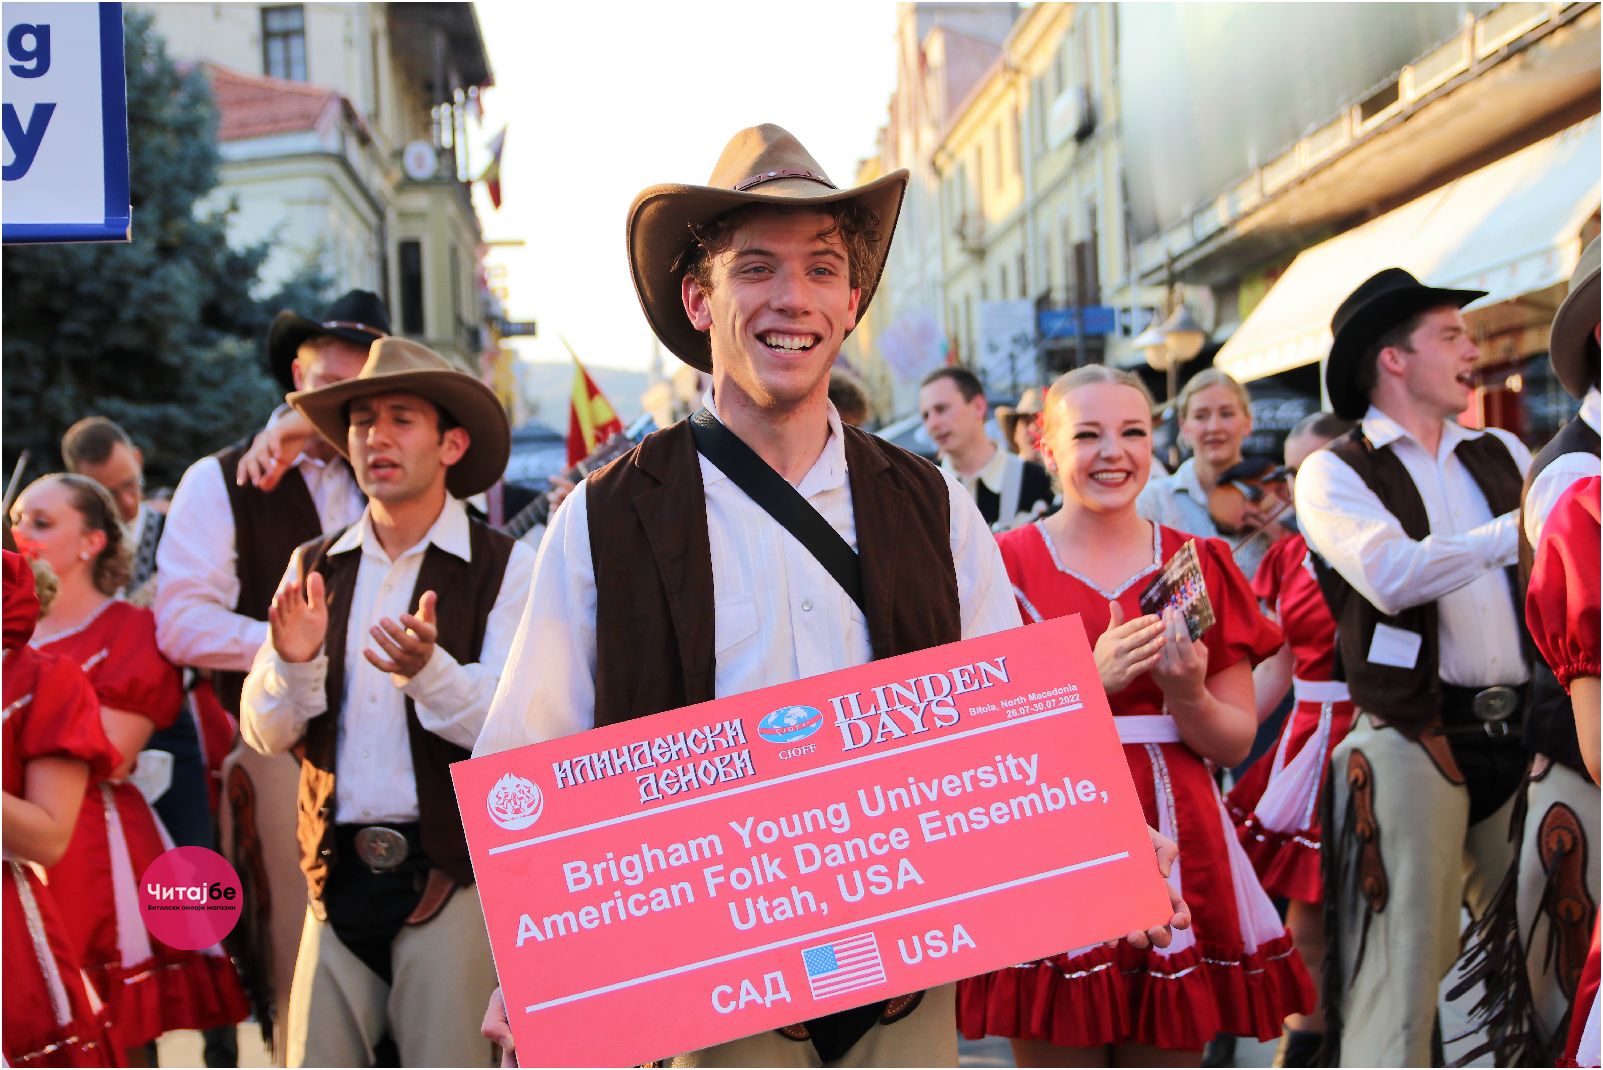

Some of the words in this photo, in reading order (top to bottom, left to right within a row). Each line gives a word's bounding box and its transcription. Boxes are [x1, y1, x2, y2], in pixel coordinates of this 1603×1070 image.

[828, 656, 1010, 726] ILINDEN
[968, 703, 999, 717] Bitola,
[1000, 696, 1026, 709] North
[1028, 683, 1078, 701] Macedonia
[1005, 693, 1081, 719] 26.07-30.07.2022
[778, 743, 817, 760] CIOFF
[835, 695, 960, 752] DAYS
[552, 718, 749, 789] ИЛИНДЕНСКИ
[636, 749, 756, 804] ДЕНОВИ
[562, 833, 723, 893] Brigham
[729, 802, 850, 849] Young
[857, 752, 1038, 817] University
[515, 880, 694, 947] American
[703, 853, 787, 898] Folk
[793, 826, 910, 875] Dance
[918, 777, 1109, 843] Ensemble,
[728, 886, 829, 931] Utah,
[836, 858, 925, 903] USA
[897, 923, 977, 965] USA
[711, 970, 792, 1014] САД
